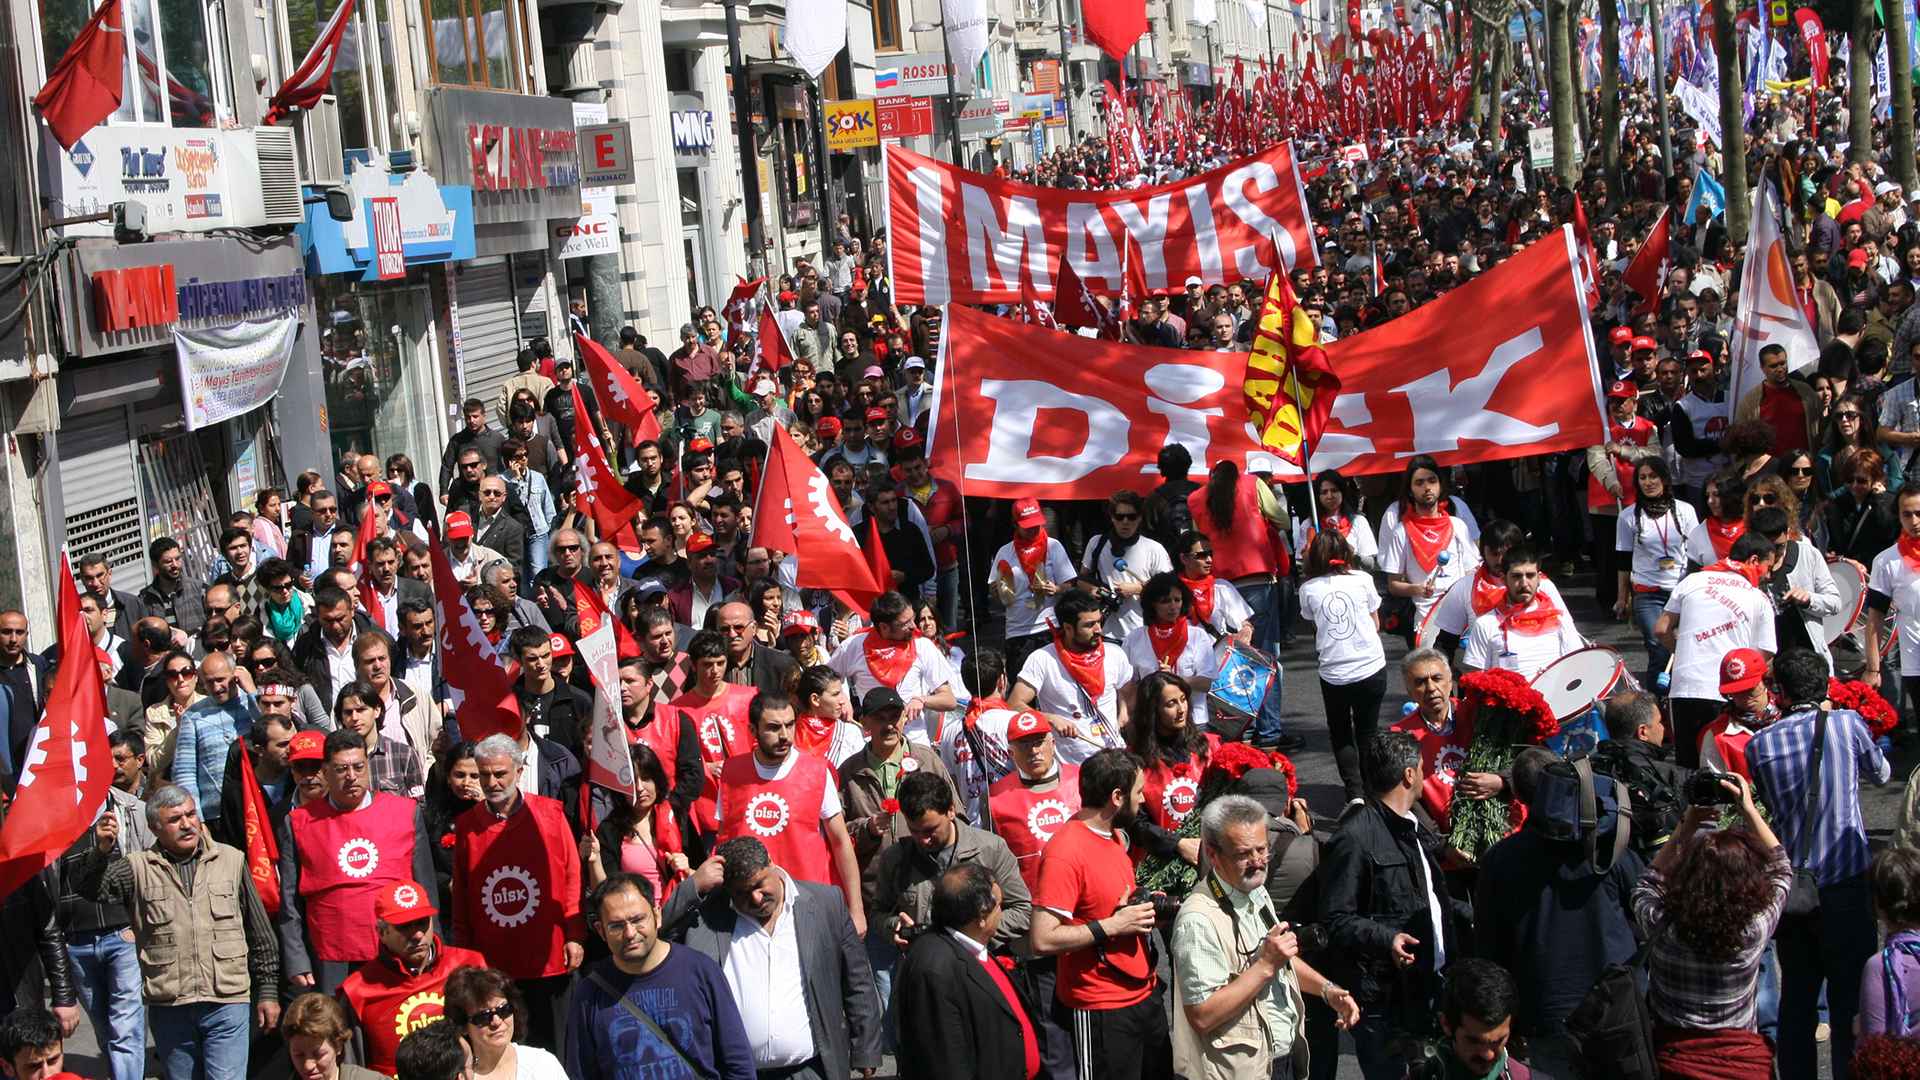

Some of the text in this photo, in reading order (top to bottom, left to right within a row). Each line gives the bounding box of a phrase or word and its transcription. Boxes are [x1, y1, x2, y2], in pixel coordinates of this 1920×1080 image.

[671, 111, 713, 147] MNG
[595, 134, 616, 168] E
[555, 222, 608, 238] GNC
[585, 237, 609, 251] Well
[961, 162, 1296, 293] MAYIS
